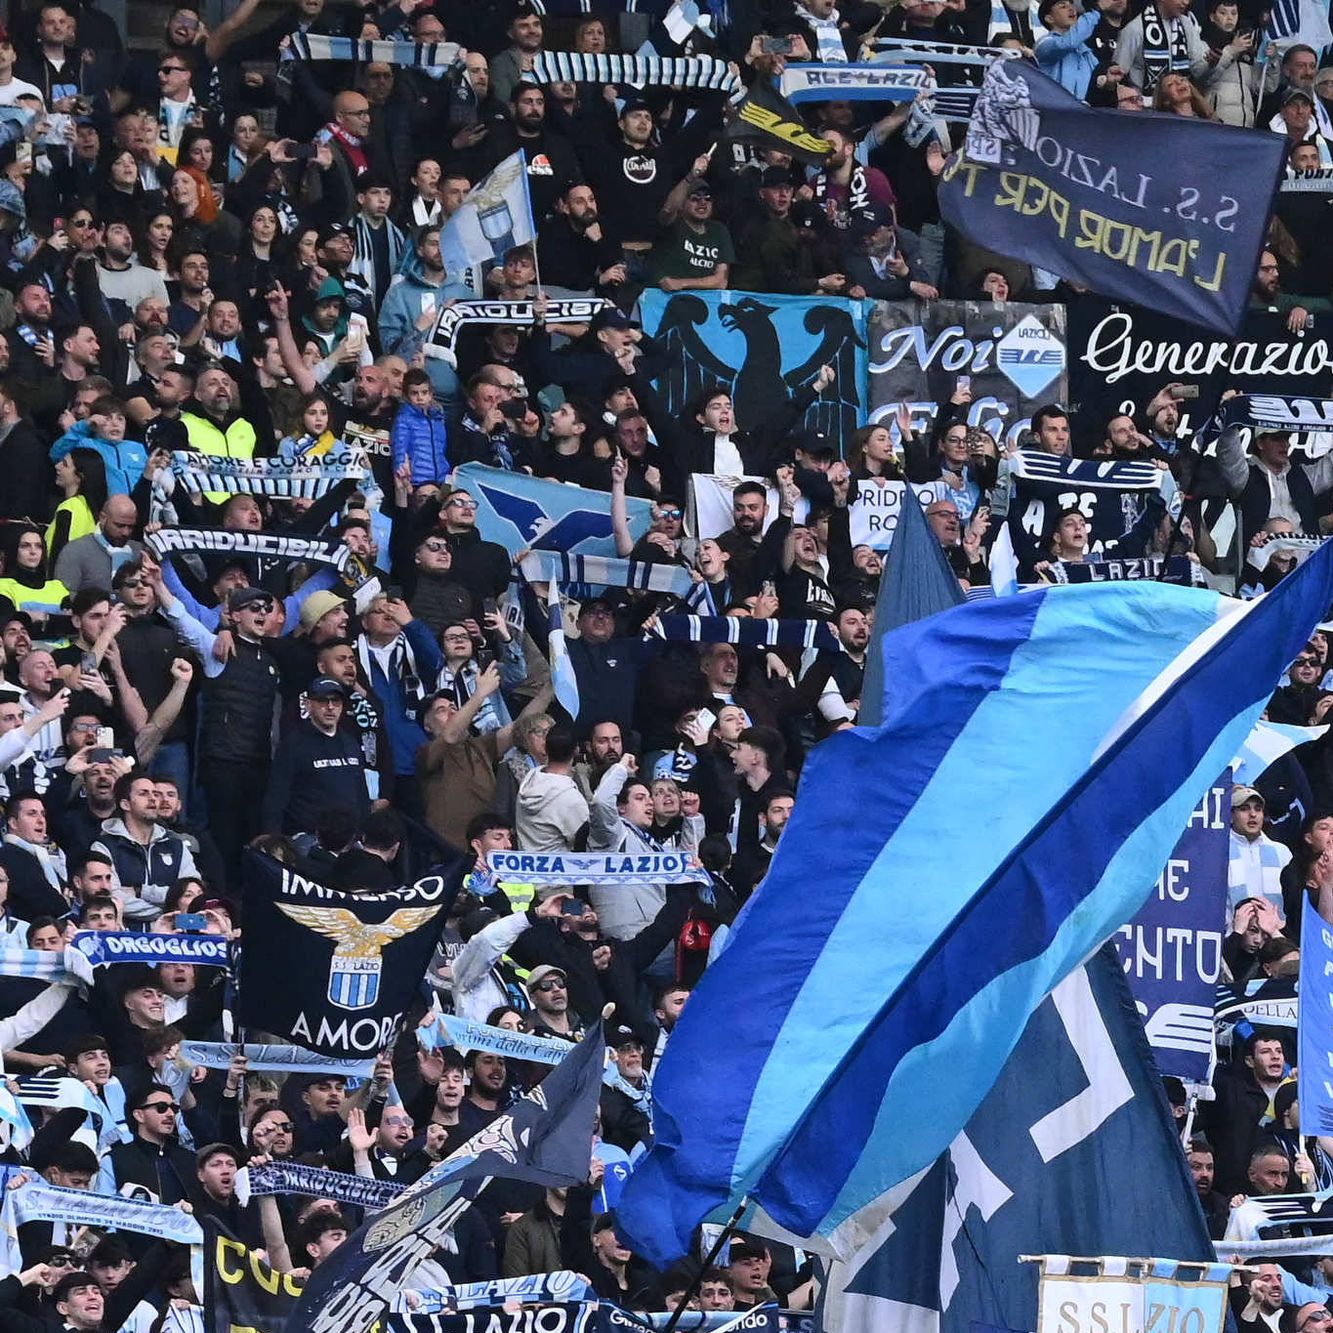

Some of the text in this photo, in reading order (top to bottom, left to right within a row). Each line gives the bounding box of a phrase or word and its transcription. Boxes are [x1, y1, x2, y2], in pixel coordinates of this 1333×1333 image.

[866, 325, 1004, 375] Noi
[492, 854, 680, 873] FORZA LAZIO
[282, 1163, 382, 1201] IRRIDUCIBILI
[456, 1271, 577, 1301] LAZIO
